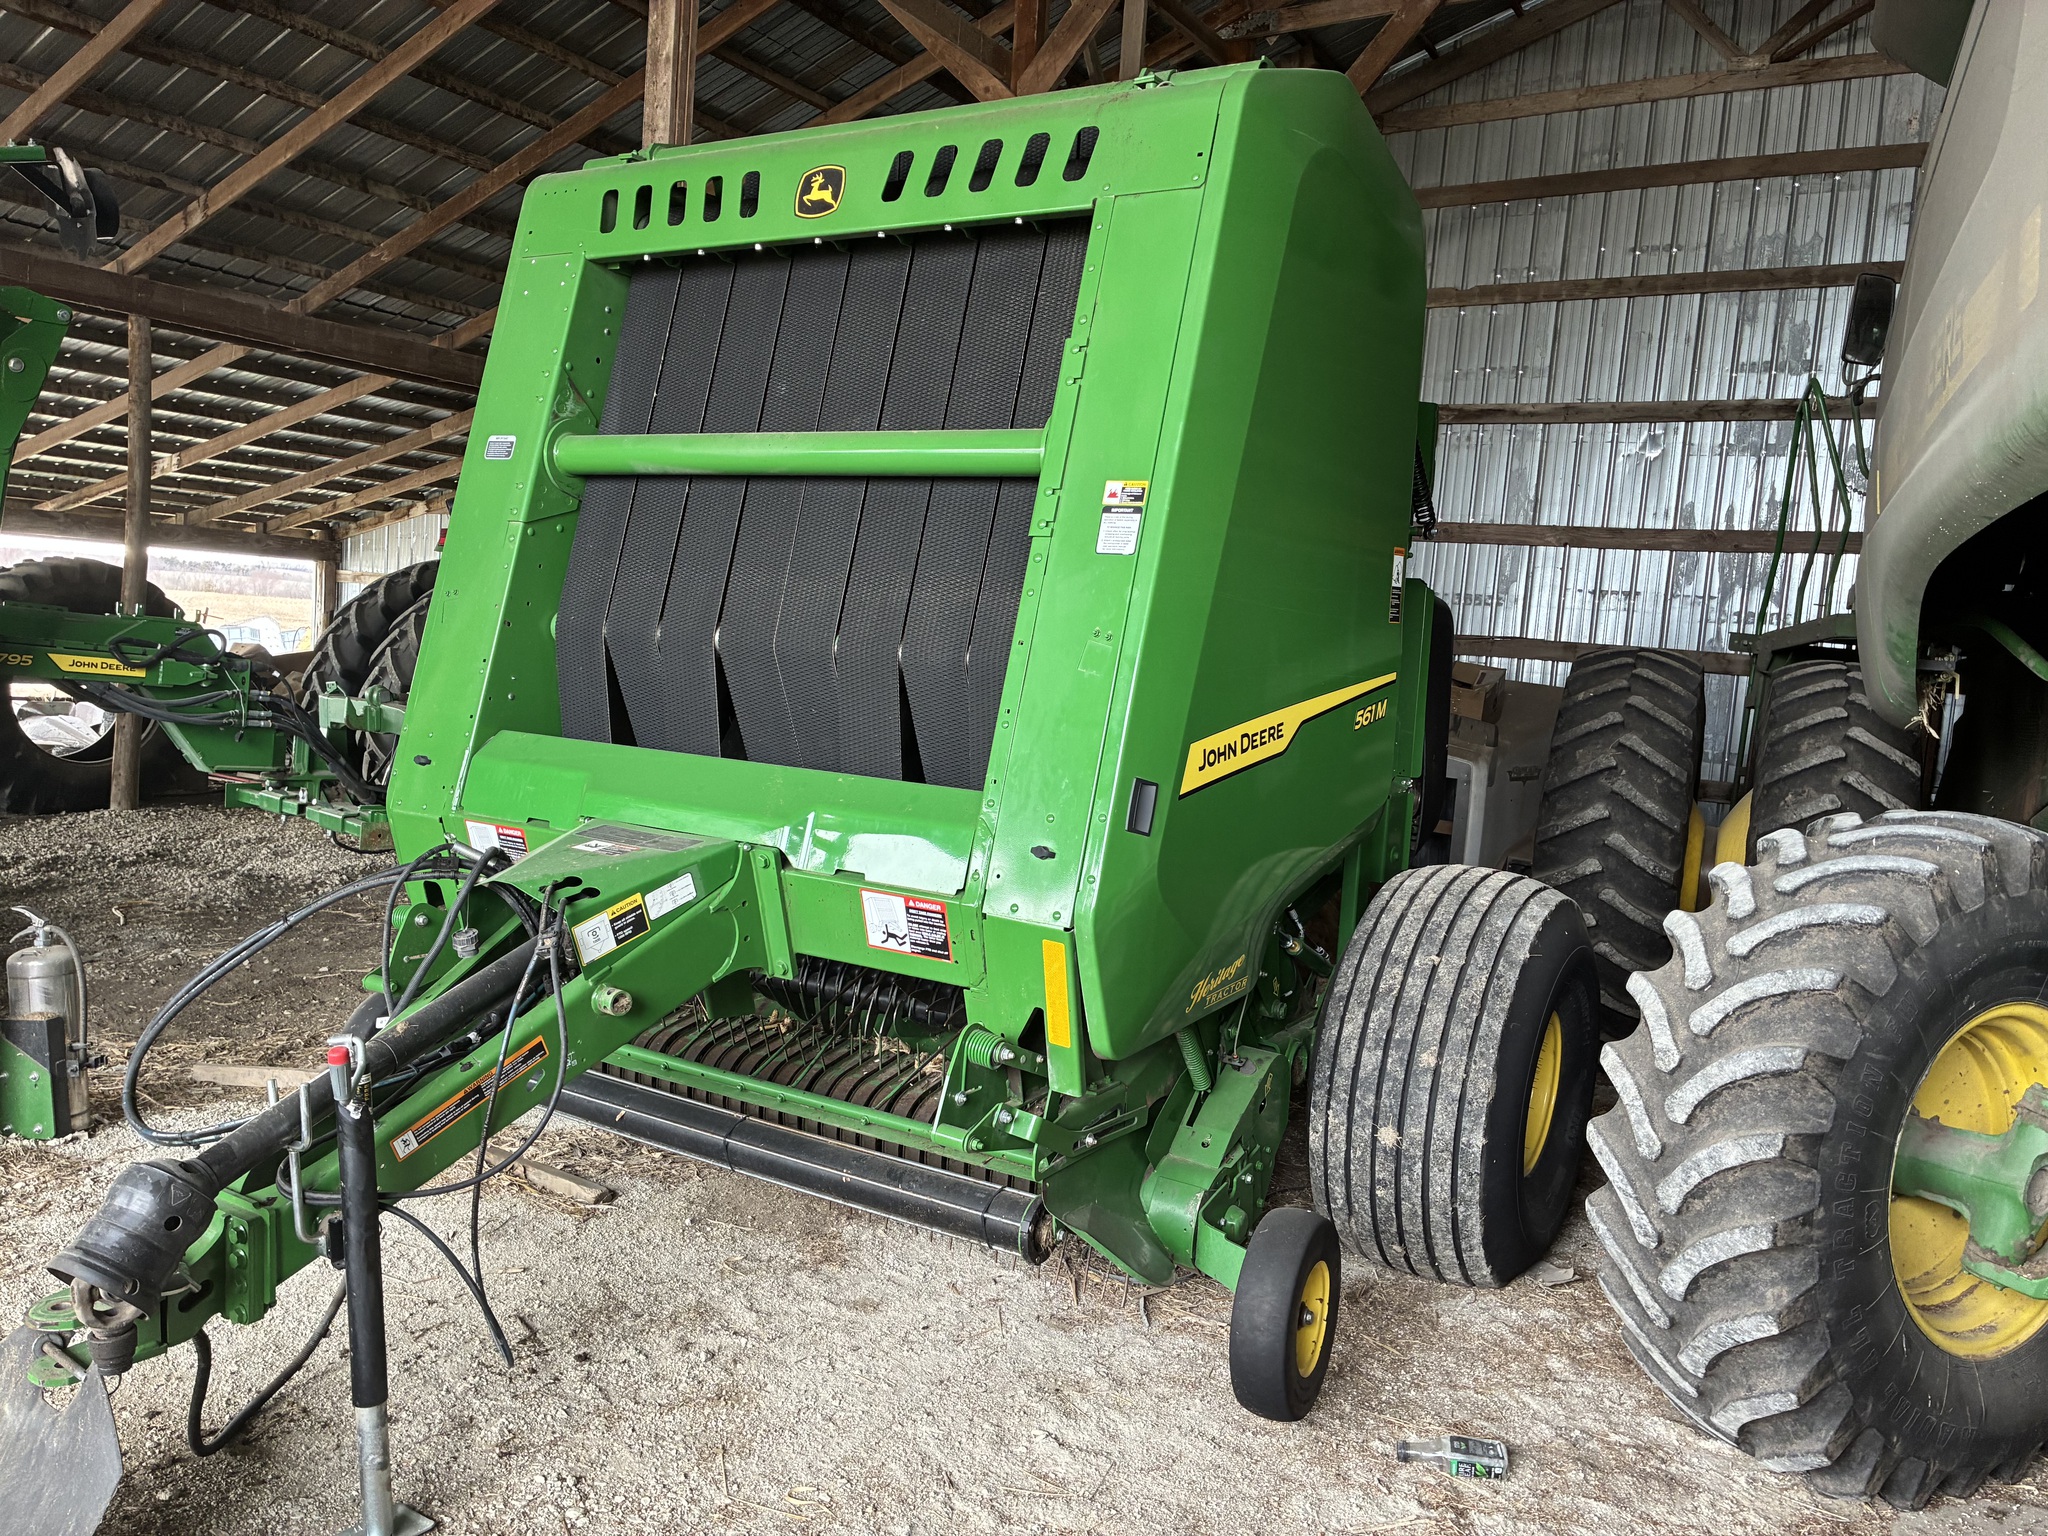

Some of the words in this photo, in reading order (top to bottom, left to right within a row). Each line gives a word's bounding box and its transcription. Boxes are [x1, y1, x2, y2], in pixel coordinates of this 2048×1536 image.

[68, 659, 98, 670] JOHN
[1198, 740, 1237, 772] JOHN
[1240, 721, 1285, 755] DEERE
[615, 898, 638, 913] CAUTION
[915, 900, 942, 911] DANGER
[1185, 953, 1246, 1014] Heritage
[1205, 978, 1248, 1006] TRACTOR
[467, 1071, 494, 1090] WARNING
[1832, 1062, 1885, 1281] TRACTION
[1841, 1303, 1880, 1379] ALL
